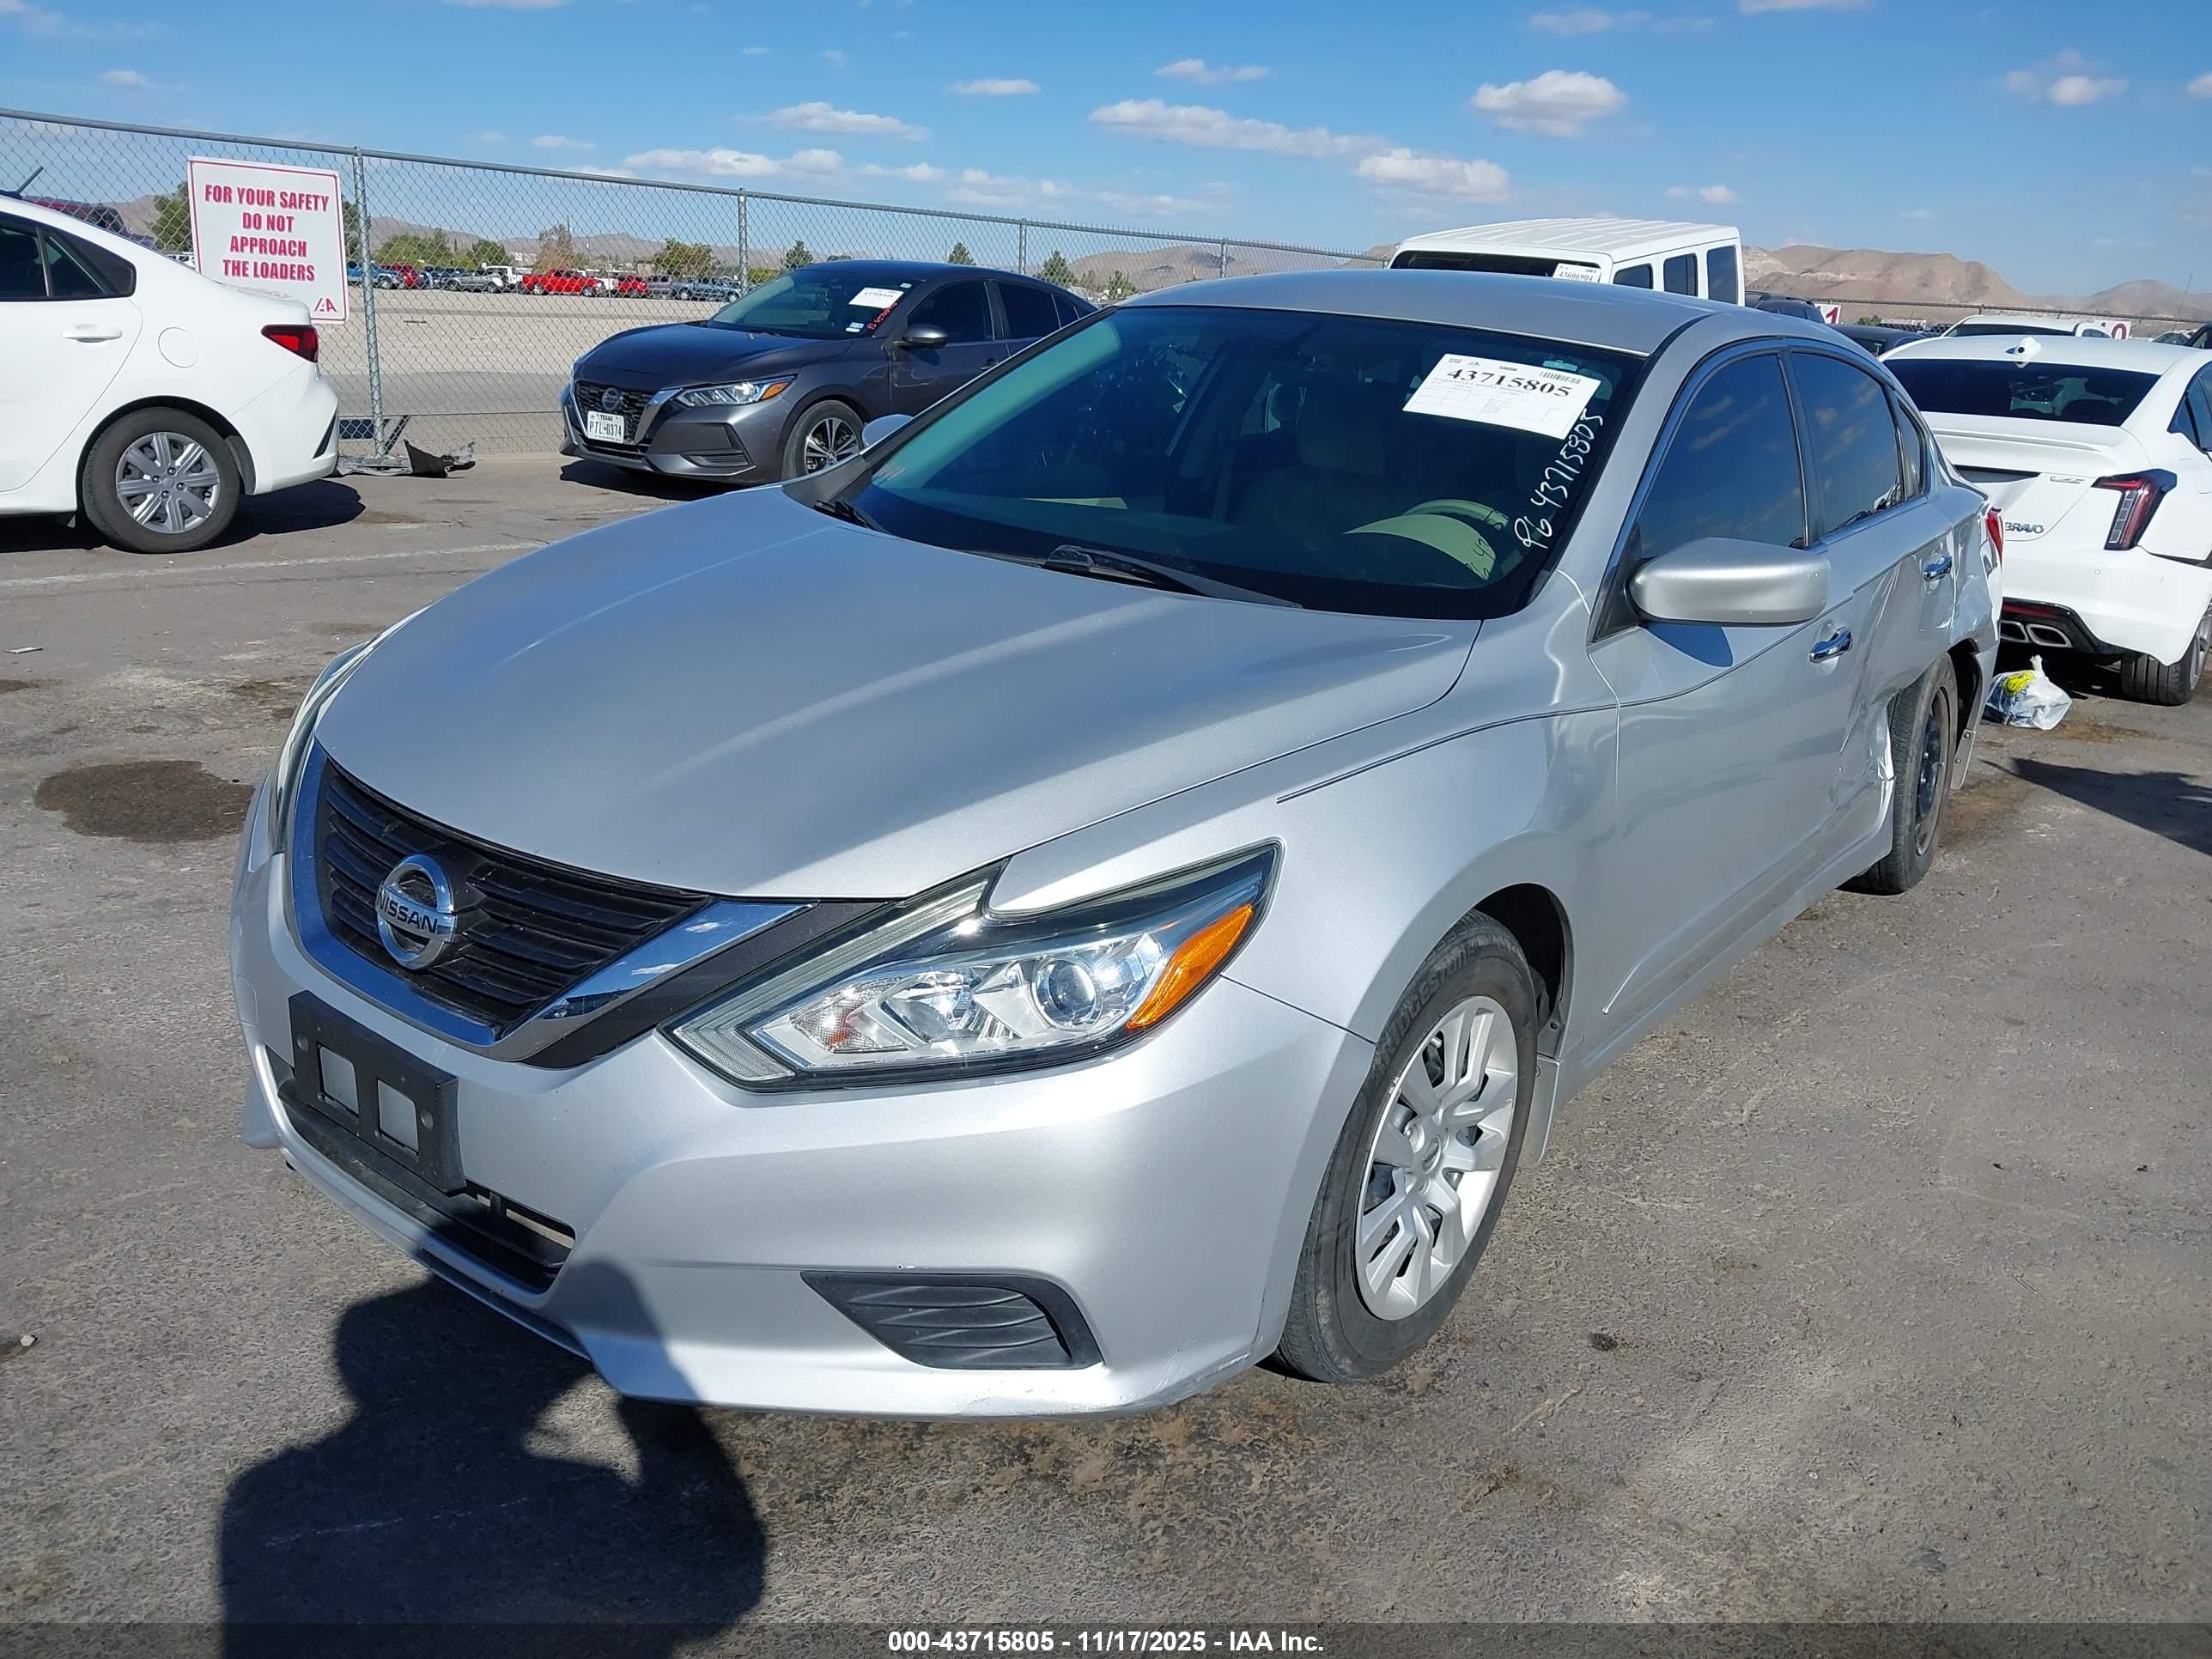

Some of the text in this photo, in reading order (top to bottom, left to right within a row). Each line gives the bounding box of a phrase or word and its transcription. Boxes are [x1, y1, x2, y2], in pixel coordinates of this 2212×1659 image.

[205, 185, 329, 212] FOR YOUR SAFETY
[242, 212, 295, 233] DO NOT
[229, 235, 307, 257] APPROACH
[222, 259, 315, 282] THE LOADERS
[1447, 368, 1573, 397] 43715805
[1530, 408, 1603, 508] 43715805
[378, 887, 438, 935] NISSAN
